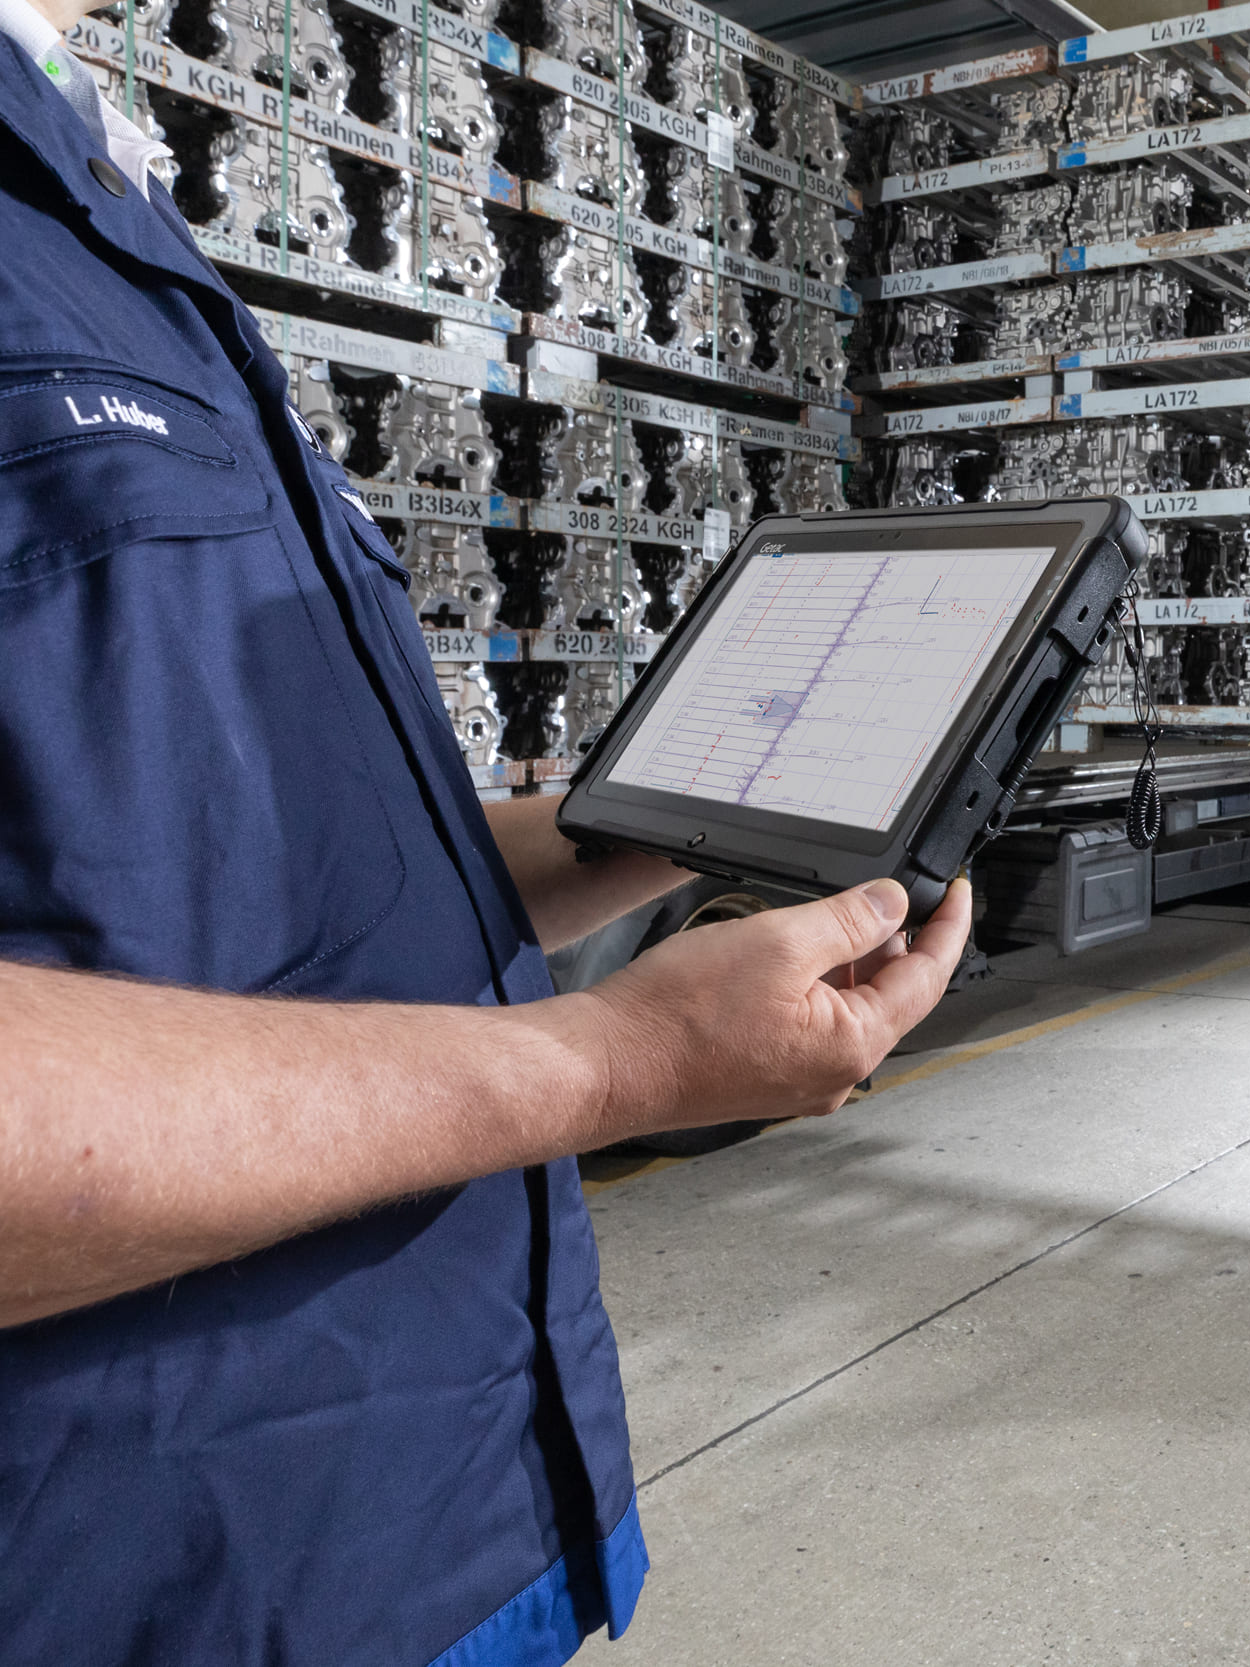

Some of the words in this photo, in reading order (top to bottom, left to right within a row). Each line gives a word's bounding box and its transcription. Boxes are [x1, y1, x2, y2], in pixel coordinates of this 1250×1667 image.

[187, 65, 246, 106] KGH
[792, 59, 840, 97] B3B4X
[571, 73, 605, 103] 620
[658, 110, 697, 142] KGH
[902, 172, 949, 193] LA172
[570, 205, 601, 230] 620
[652, 232, 689, 258] KGH
[883, 276, 922, 296] LA172
[657, 350, 693, 374] KGH
[1106, 345, 1150, 363] LA172
[1144, 390, 1199, 410] LA172
[101, 395, 169, 436] Huber
[658, 403, 695, 426] KGH
[886, 414, 924, 431] LA172
[408, 493, 483, 520] B3B4X
[1144, 496, 1198, 514] LA172
[568, 510, 600, 531] 308
[657, 521, 695, 541] KGH
[424, 635, 476, 654] 3B4X
